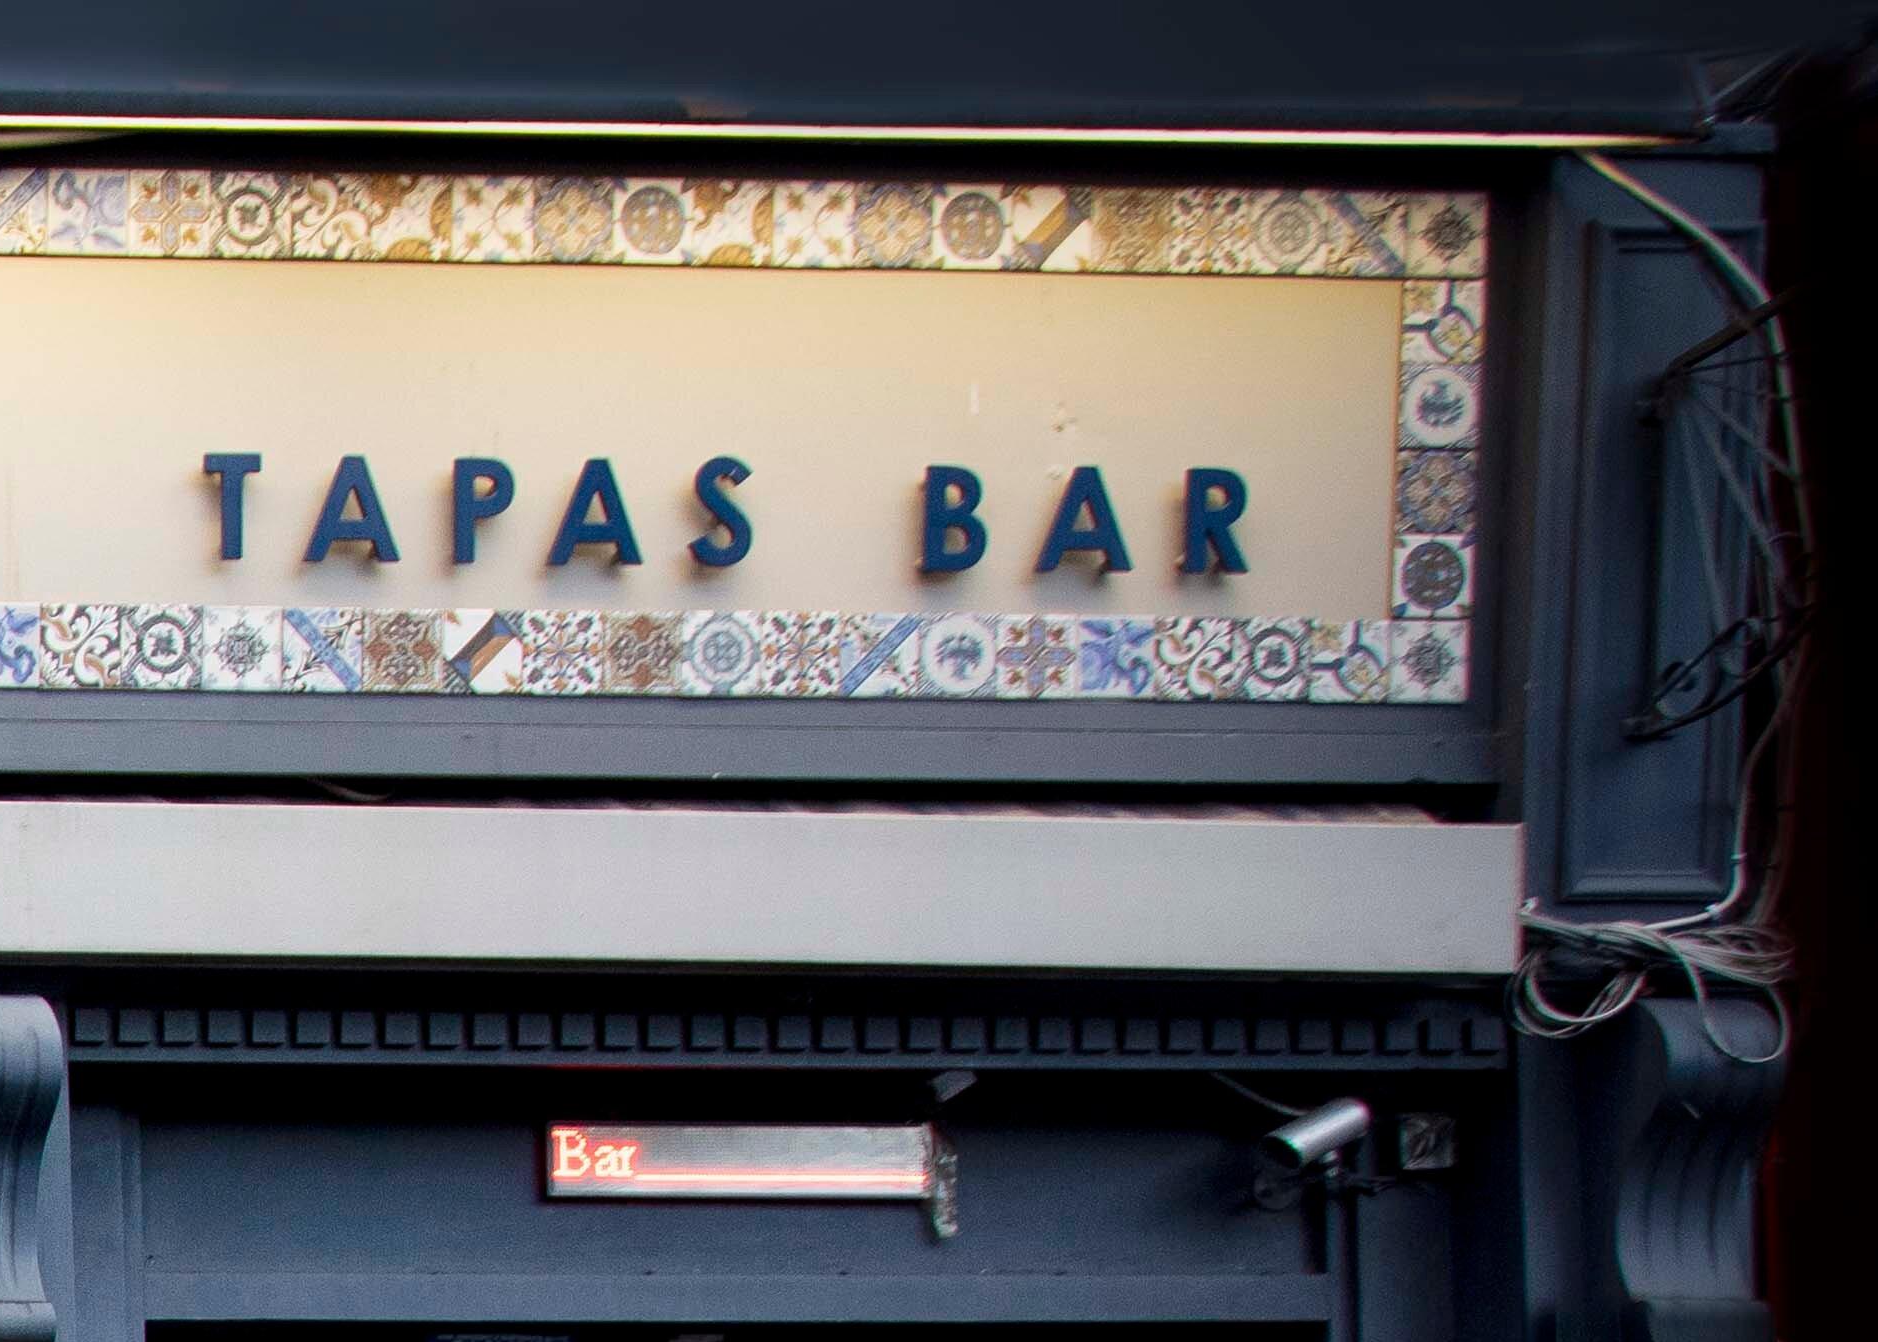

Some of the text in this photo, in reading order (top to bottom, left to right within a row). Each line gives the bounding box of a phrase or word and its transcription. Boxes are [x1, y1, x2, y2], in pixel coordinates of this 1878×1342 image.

[203, 451, 1250, 576] TAPAS BAR
[552, 1129, 639, 1178] Bar
